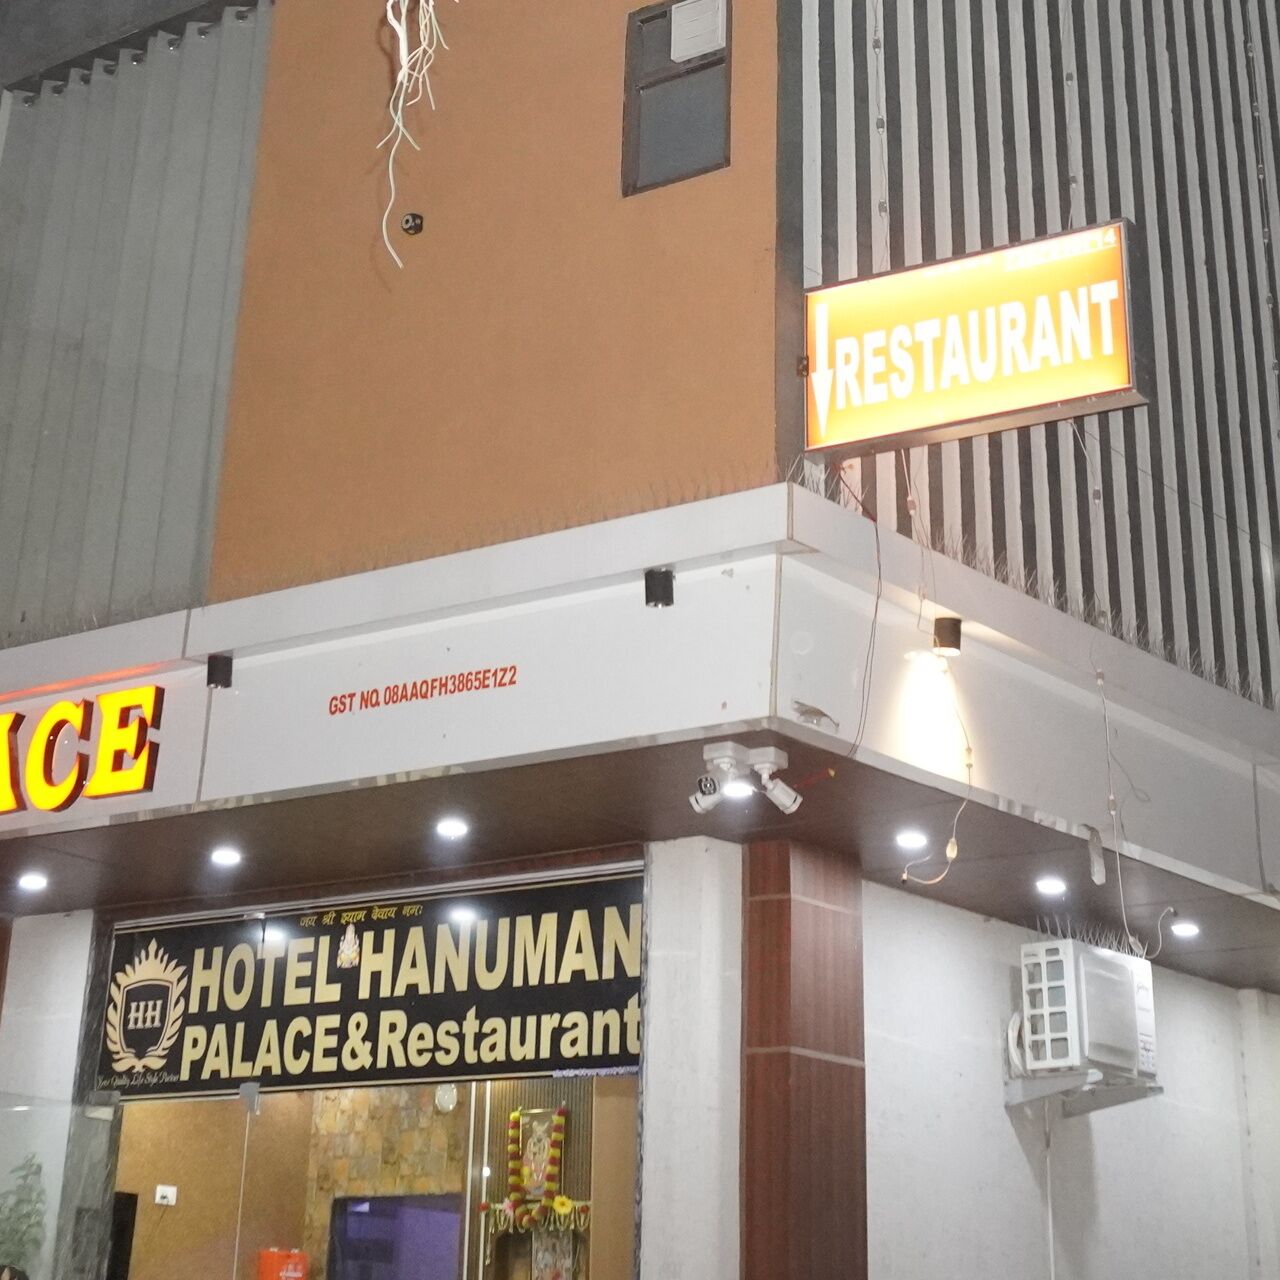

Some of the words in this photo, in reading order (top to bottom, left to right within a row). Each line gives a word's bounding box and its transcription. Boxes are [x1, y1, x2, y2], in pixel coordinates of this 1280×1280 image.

[835, 279, 1119, 412] RESTAURANT
[328, 692, 356, 716] GST
[383, 664, 518, 706] 08AAQFH3865E1Z2
[187, 934, 341, 1014] HOTEL
[358, 903, 643, 1000] HANUMAN
[127, 999, 163, 1030] HH
